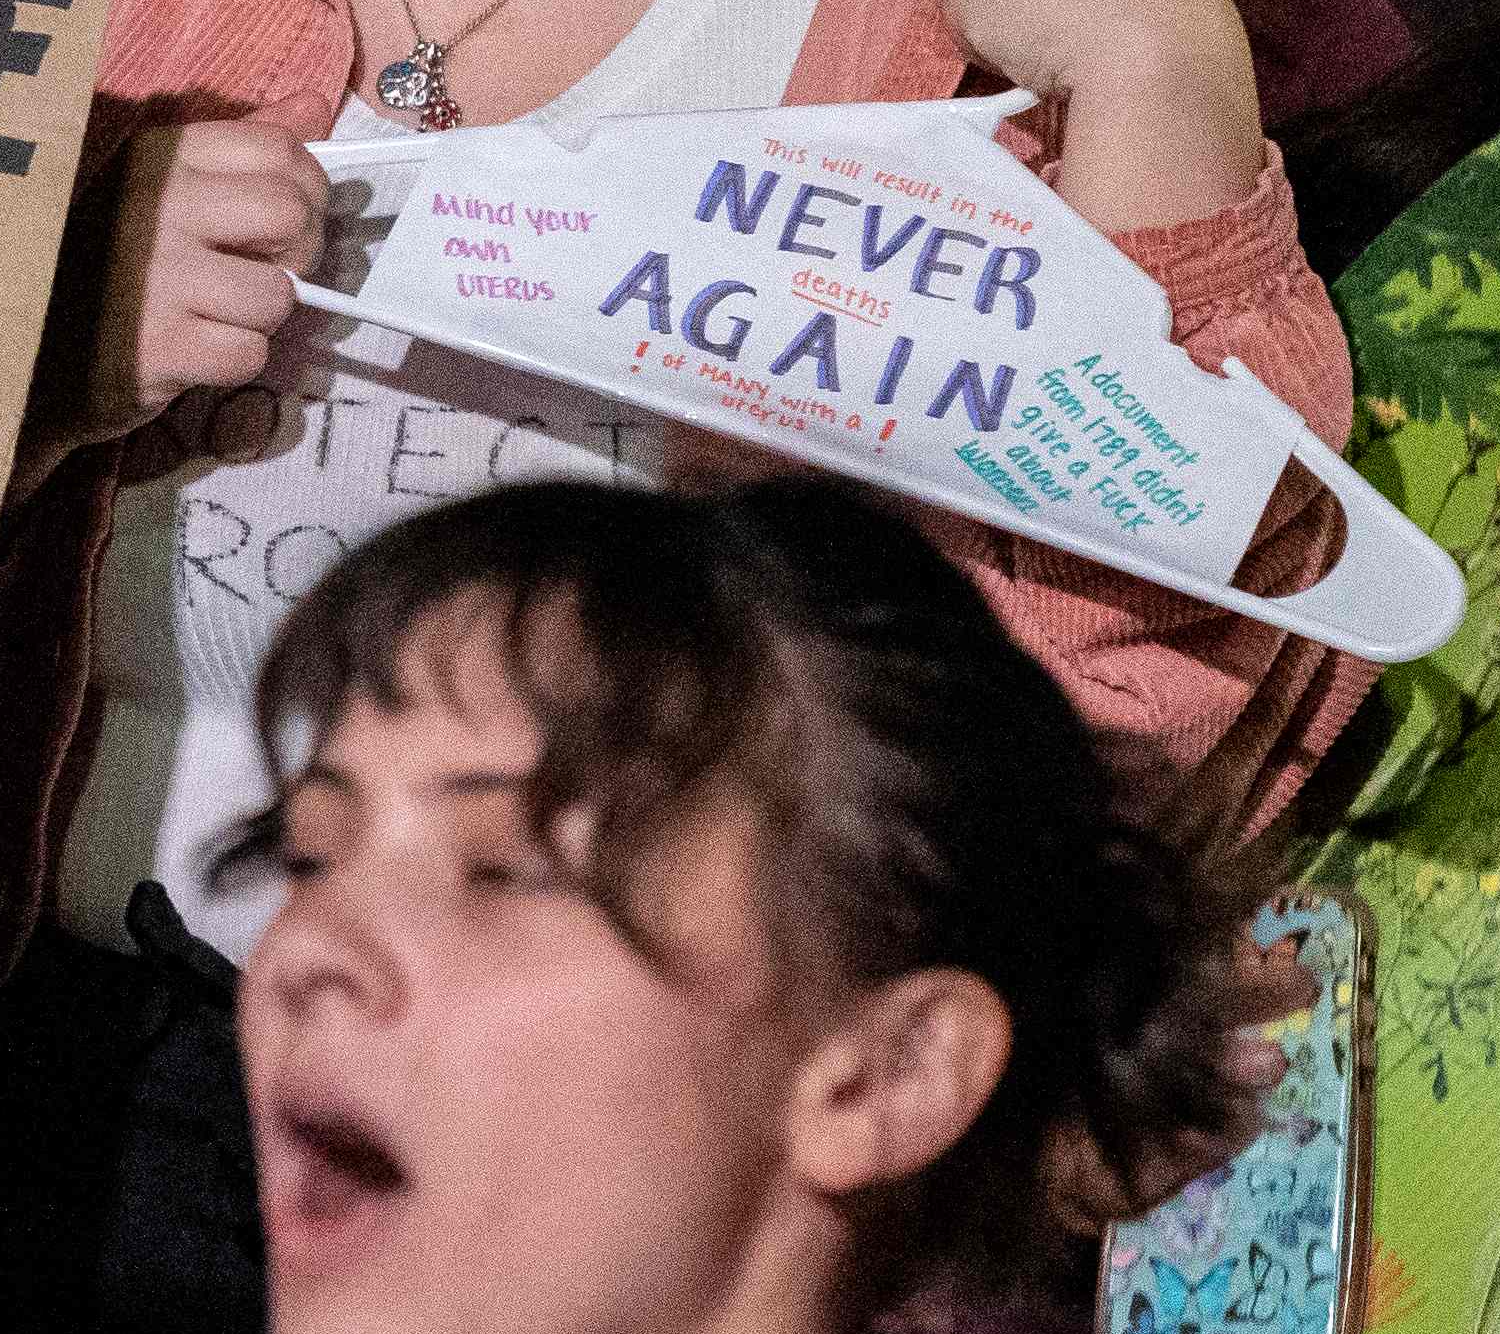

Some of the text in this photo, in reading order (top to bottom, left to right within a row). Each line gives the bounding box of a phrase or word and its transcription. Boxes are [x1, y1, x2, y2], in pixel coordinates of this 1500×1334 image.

[432, 193, 515, 227] Mind
[764, 137, 1033, 235] This will result in the
[695, 160, 1042, 331] NEVER
[457, 273, 555, 302] UTERUS
[792, 267, 892, 321] deaths
[598, 250, 1017, 432] AGAIN
[780, 396, 836, 423] with
[1010, 405, 1071, 457] give
[1067, 461, 1091, 480] a
[1036, 368, 1086, 421] from
[1081, 415, 1141, 471] 1789
[1073, 354, 1199, 467] A document
[1006, 444, 1072, 503] about
